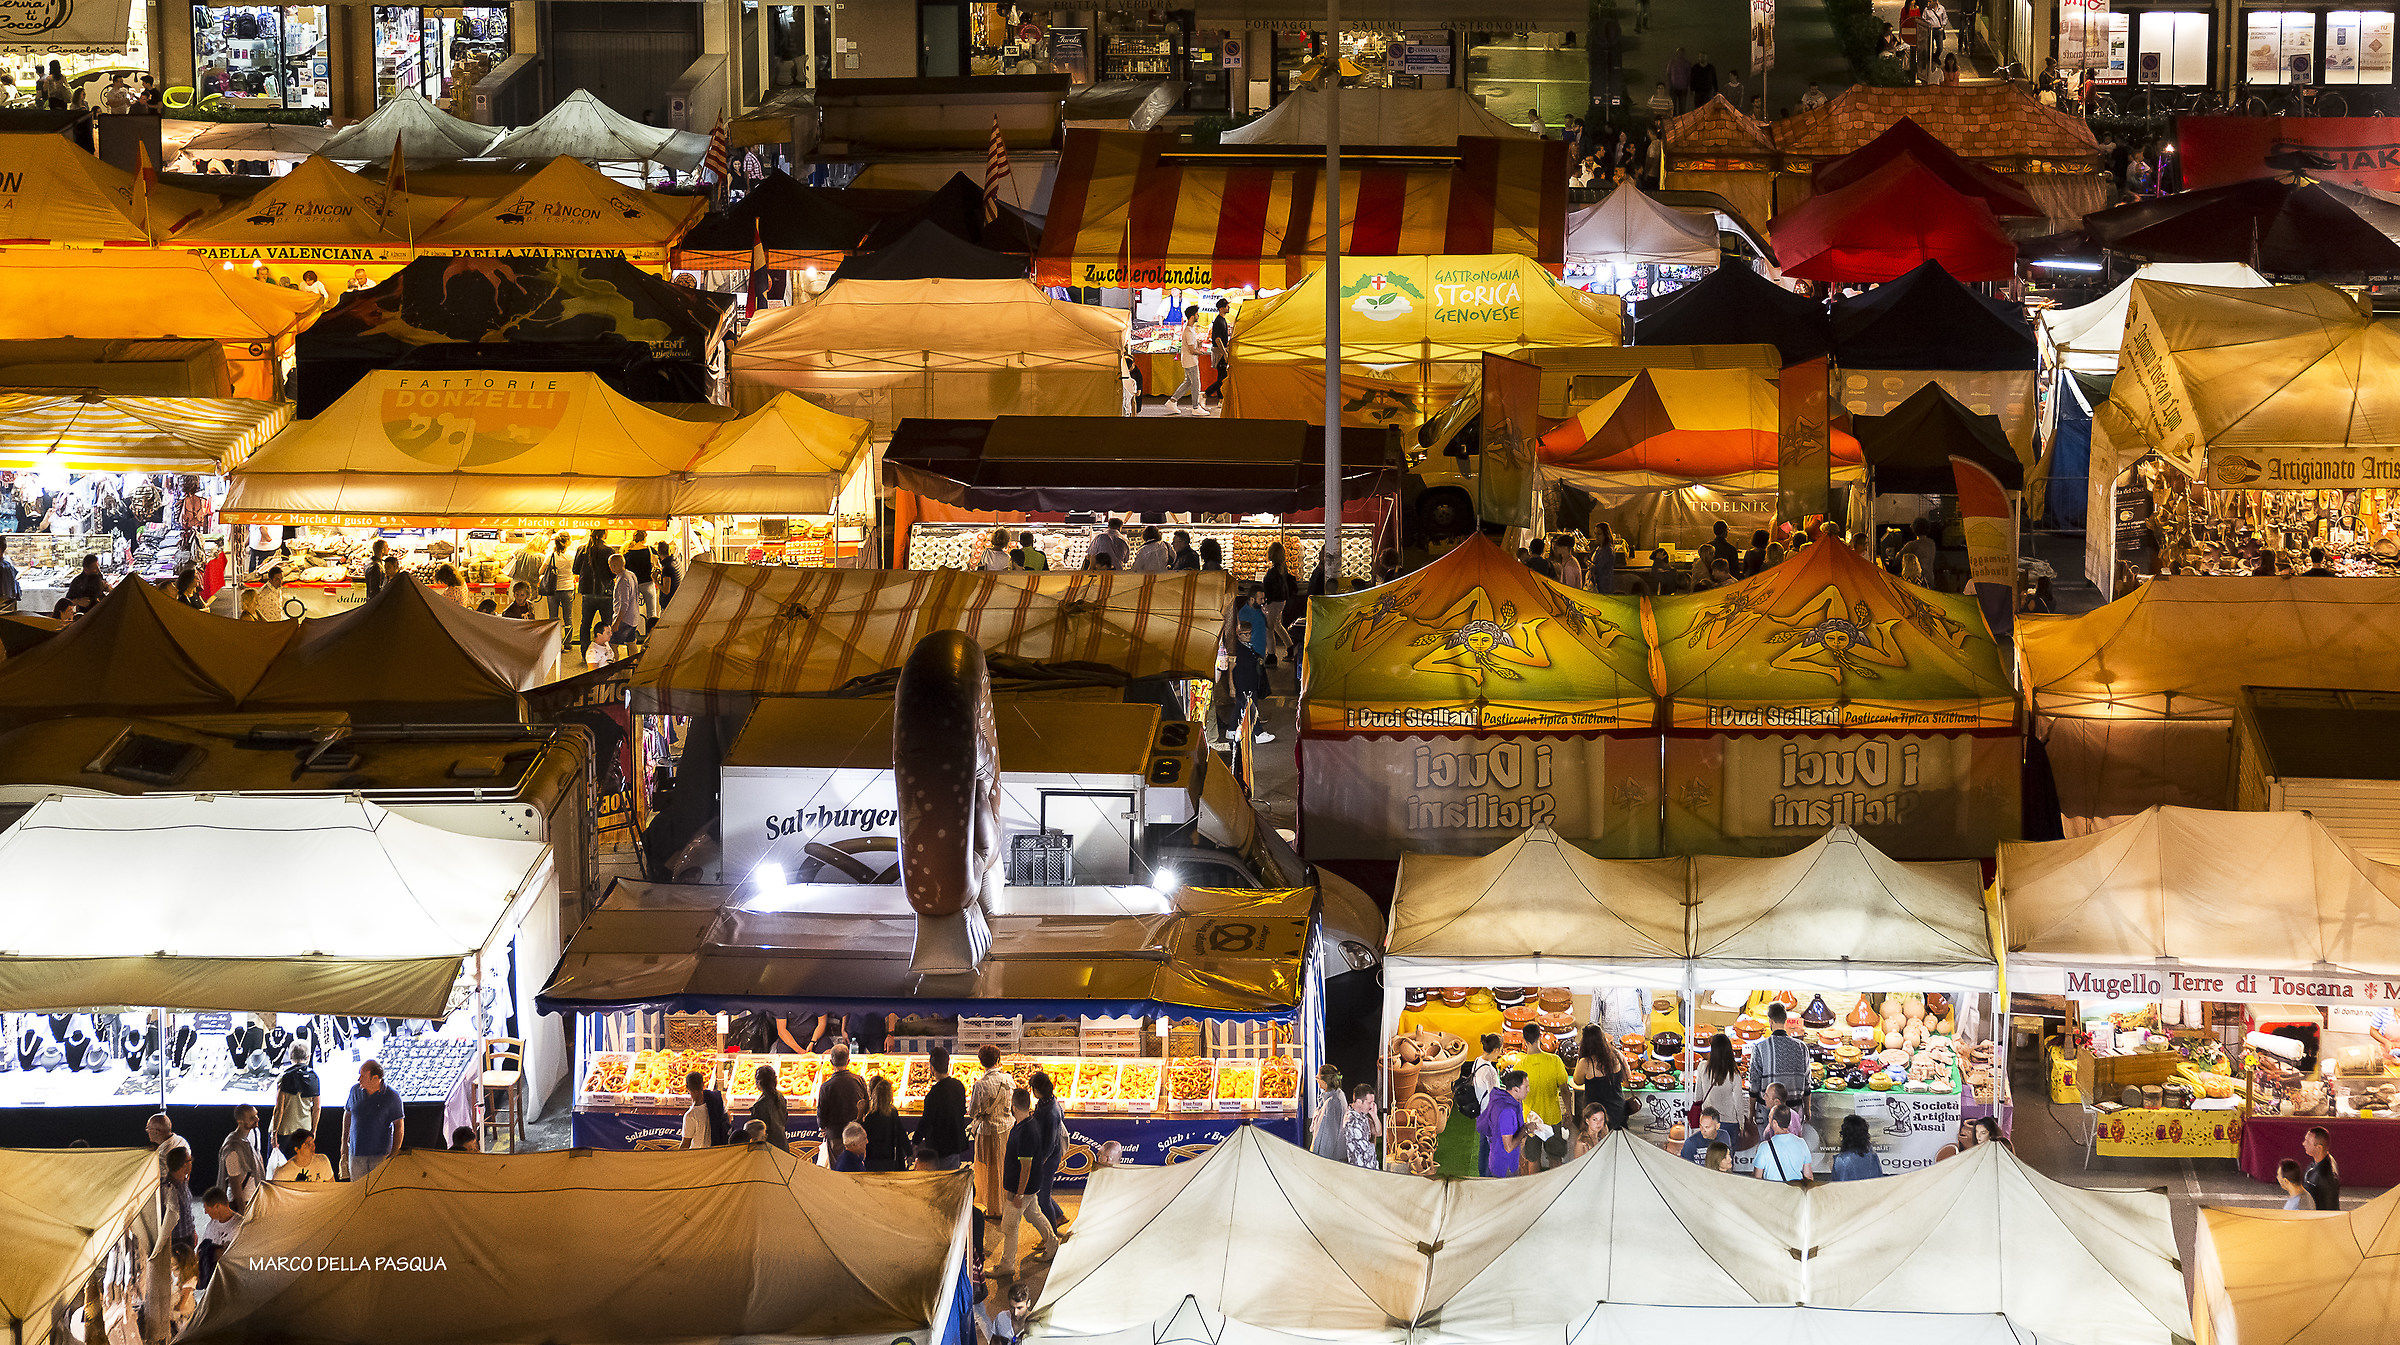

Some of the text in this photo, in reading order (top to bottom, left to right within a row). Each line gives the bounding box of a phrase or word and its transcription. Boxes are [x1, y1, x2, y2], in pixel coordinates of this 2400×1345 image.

[1246, 20, 1402, 30] FORMAGGI SALUMI
[1440, 21, 1538, 30] GASTRONOMIA
[198, 248, 262, 260] PAELLA
[267, 248, 374, 260] VALENCIANA
[520, 249, 627, 259] VALENCIANA
[1084, 264, 1212, 285] Zuccherolandia
[1434, 268, 1520, 283] GASTRONOMIA
[1433, 282, 1521, 306] STORICA
[1434, 306, 1520, 323] GENOVESE
[399, 378, 557, 390] FATTORIE
[395, 390, 555, 409] DONZELLI
[2267, 457, 2356, 485] Artigianato
[290, 514, 328, 525] Marche
[331, 514, 341, 525] di
[344, 516, 373, 527] gusto
[517, 517, 601, 528] Marche di gusto
[1360, 708, 1402, 727] Duci
[1405, 707, 1478, 728] Siciliani
[1483, 712, 1538, 728] Pasticceria
[1538, 713, 1568, 727] Tipica
[1571, 712, 1617, 726] Siciliana
[1720, 707, 1763, 726] Duci
[1767, 706, 1840, 727] Siciliani
[1844, 711, 1899, 726] Pasticceria
[1900, 712, 1930, 726] Tipica
[1932, 711, 1978, 725] Siciliana
[765, 805, 898, 841] Salzburger
[2067, 971, 2161, 999] Mugello
[2168, 972, 2224, 993] Terre
[2235, 975, 2257, 994] di
[2269, 976, 2354, 998] Toscana
[1912, 1101, 1959, 1111] Società
[625, 1127, 670, 1143] Salzburger
[1912, 1123, 1946, 1132] Vasai
